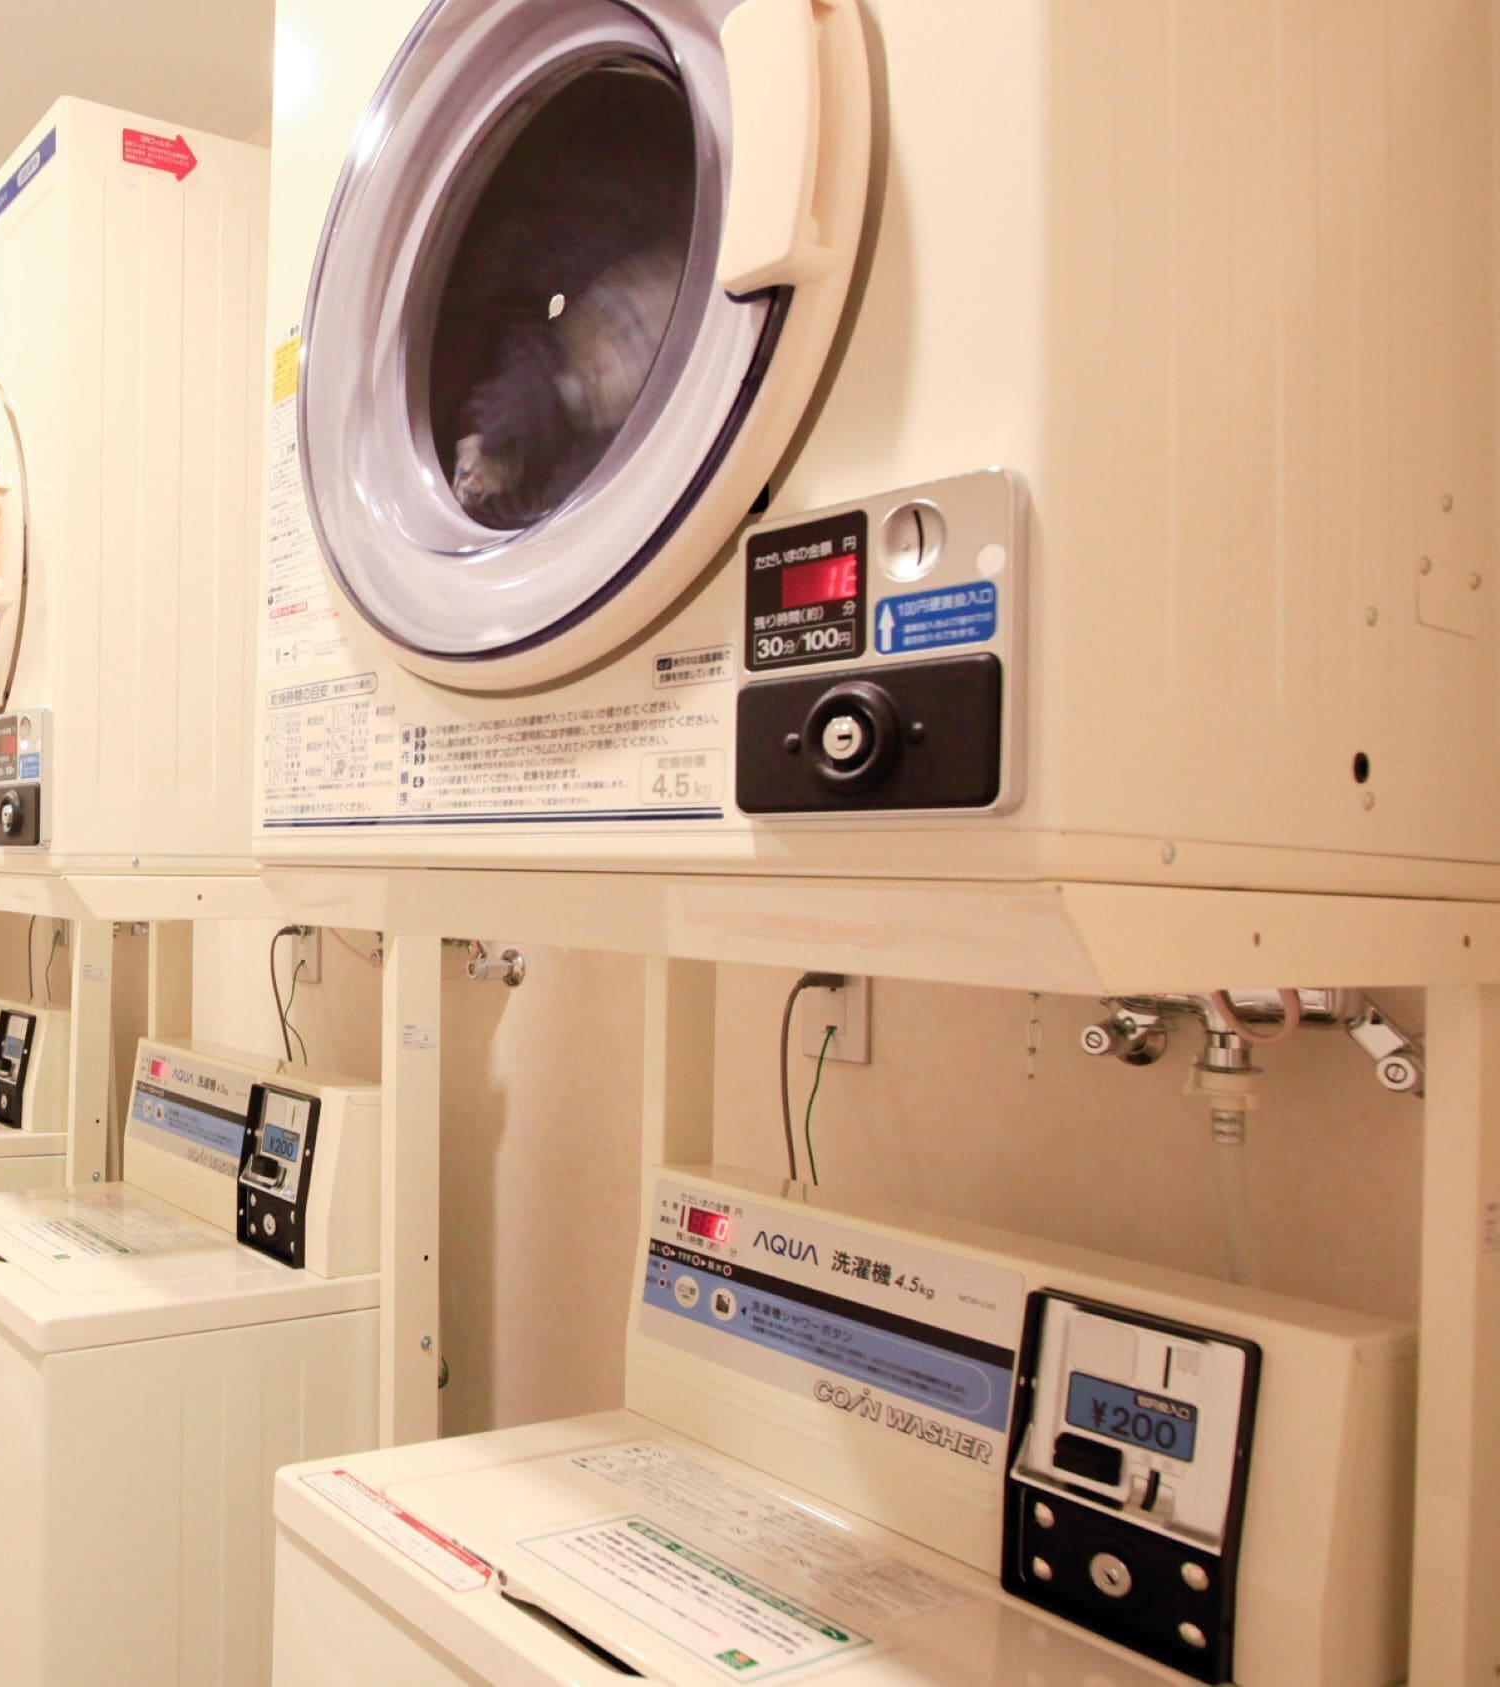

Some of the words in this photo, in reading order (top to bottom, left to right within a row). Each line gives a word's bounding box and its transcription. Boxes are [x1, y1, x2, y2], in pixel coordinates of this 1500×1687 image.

[753, 540, 833, 571] ただいまの金額
[842, 535, 857, 552] 円
[842, 600, 857, 616] 分
[752, 1230, 819, 1266] AQUA
[831, 1249, 892, 1288] 洗濯機
[895, 1273, 935, 1300] 4.5kg
[813, 1378, 882, 1424] COIN
[886, 1405, 994, 1465] WASHER
[1091, 1397, 1178, 1450] ¥200
